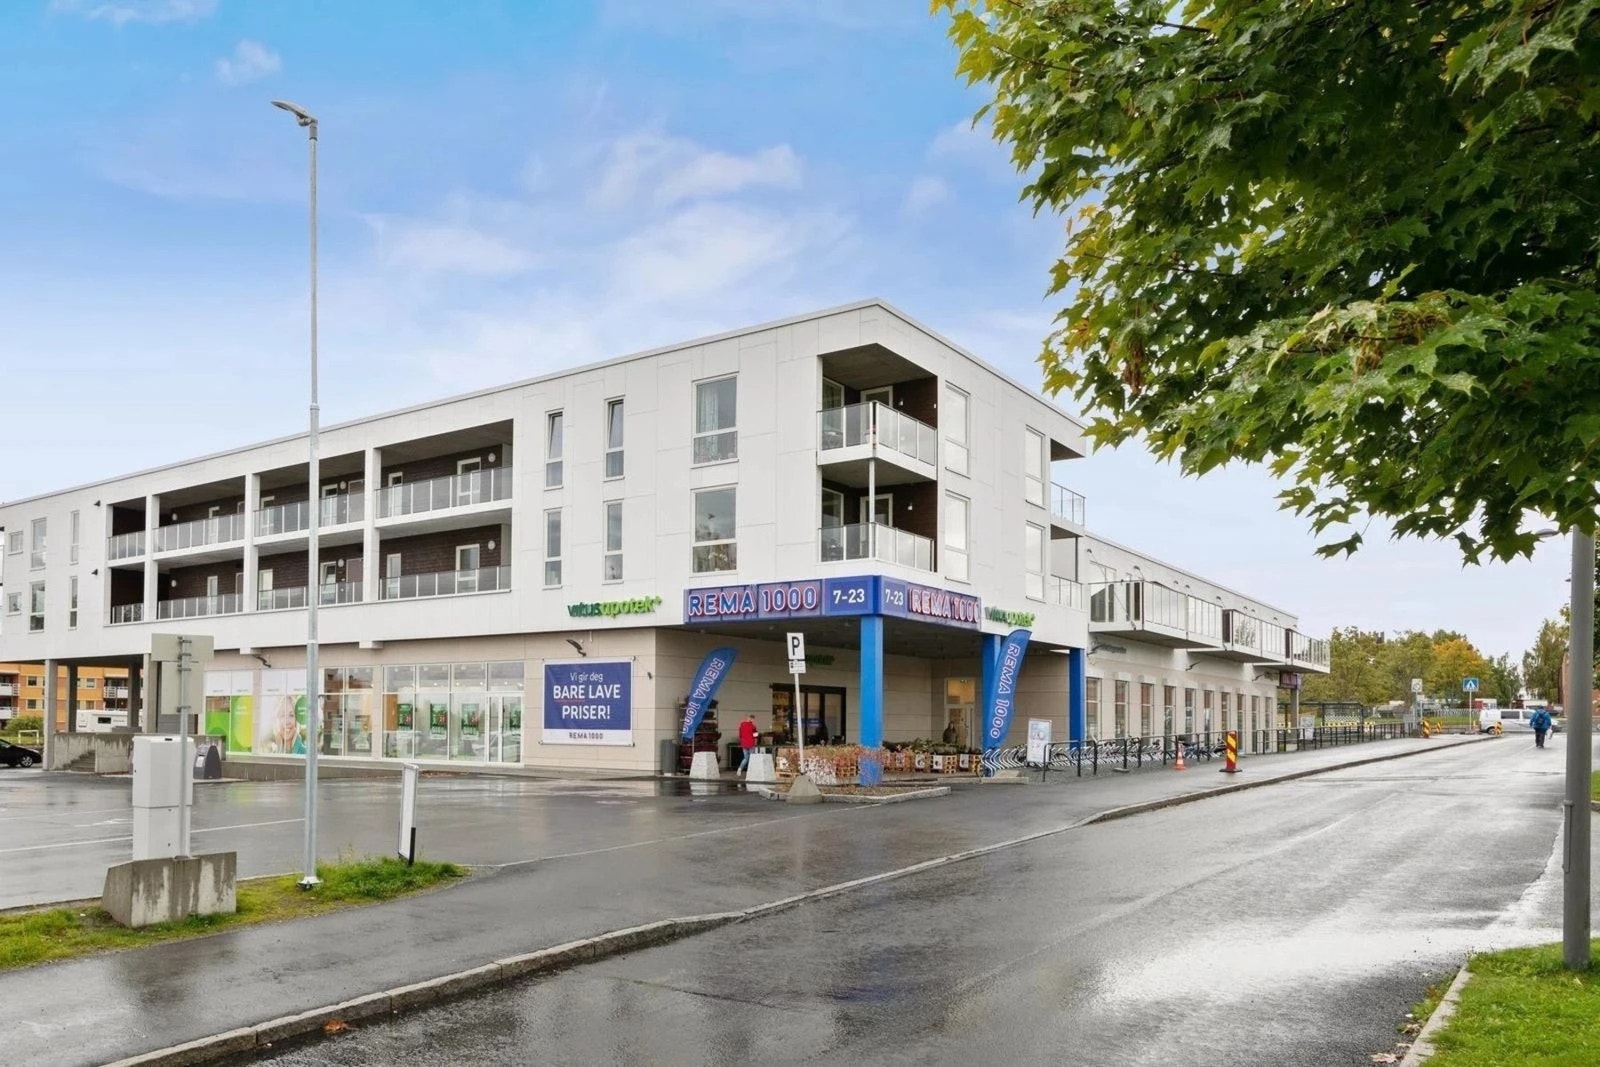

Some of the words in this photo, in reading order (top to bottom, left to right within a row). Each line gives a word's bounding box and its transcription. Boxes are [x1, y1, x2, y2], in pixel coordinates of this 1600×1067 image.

[688, 591, 755, 616] REMA
[761, 586, 817, 612] 1000
[833, 588, 866, 604] 7-23
[885, 588, 904, 606] 7-23
[909, 588, 951, 618] REMA
[791, 636, 800, 656] P
[569, 672, 578, 681] Vi
[578, 672, 589, 683] gir
[589, 671, 604, 683] deg
[692, 657, 725, 699] REMA
[997, 643, 1021, 694] REMA
[553, 685, 585, 699] BARE
[588, 684, 621, 699] LAVE
[561, 705, 611, 720] PRISER!
[990, 699, 1010, 739] 1000
[568, 731, 588, 740] REMA
[588, 731, 604, 740] 1000
